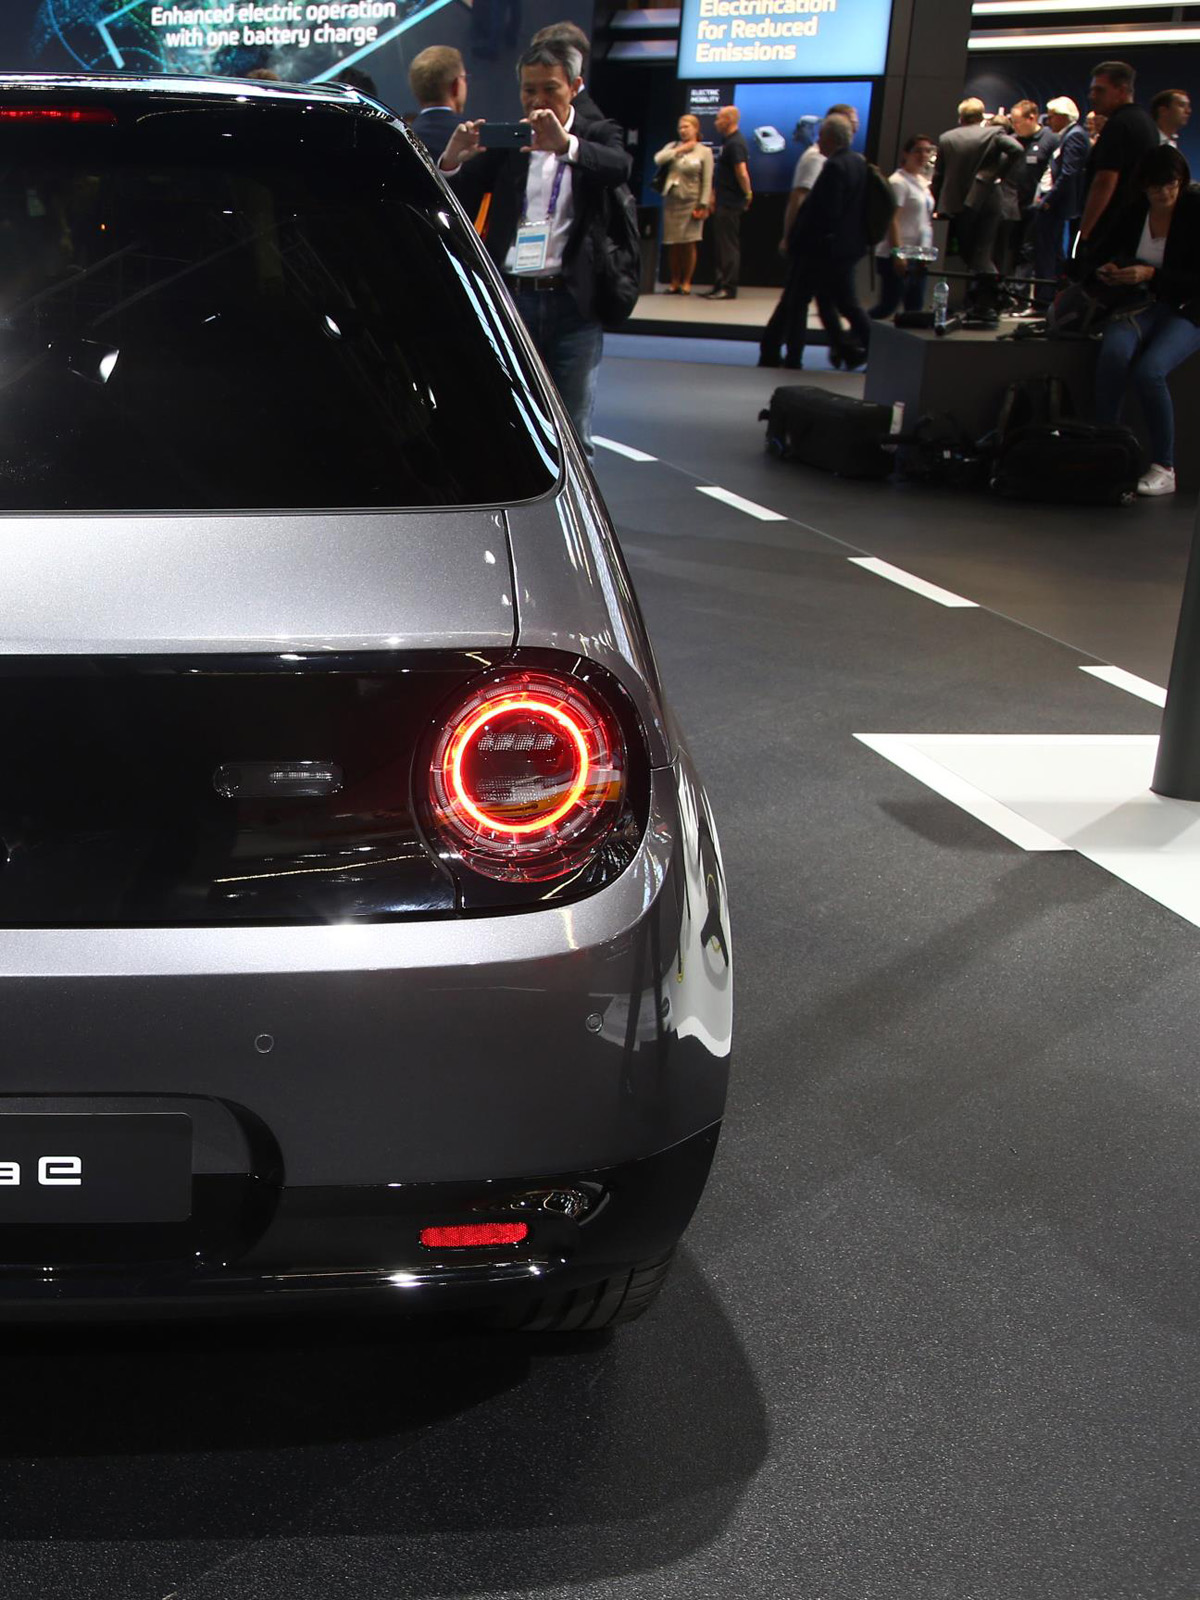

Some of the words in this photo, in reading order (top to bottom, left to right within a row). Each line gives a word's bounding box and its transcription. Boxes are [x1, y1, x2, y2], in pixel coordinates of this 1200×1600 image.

[151, 3, 234, 26] Enhanced
[238, 1, 302, 23] electric
[305, 0, 396, 24] operation
[700, 0, 836, 17] Electrification
[165, 27, 203, 47] with
[206, 30, 240, 46] one
[243, 25, 310, 48] battery
[314, 23, 378, 46] charge
[697, 20, 727, 40] for
[731, 15, 818, 38] Reduced
[696, 41, 797, 62] Emissions
